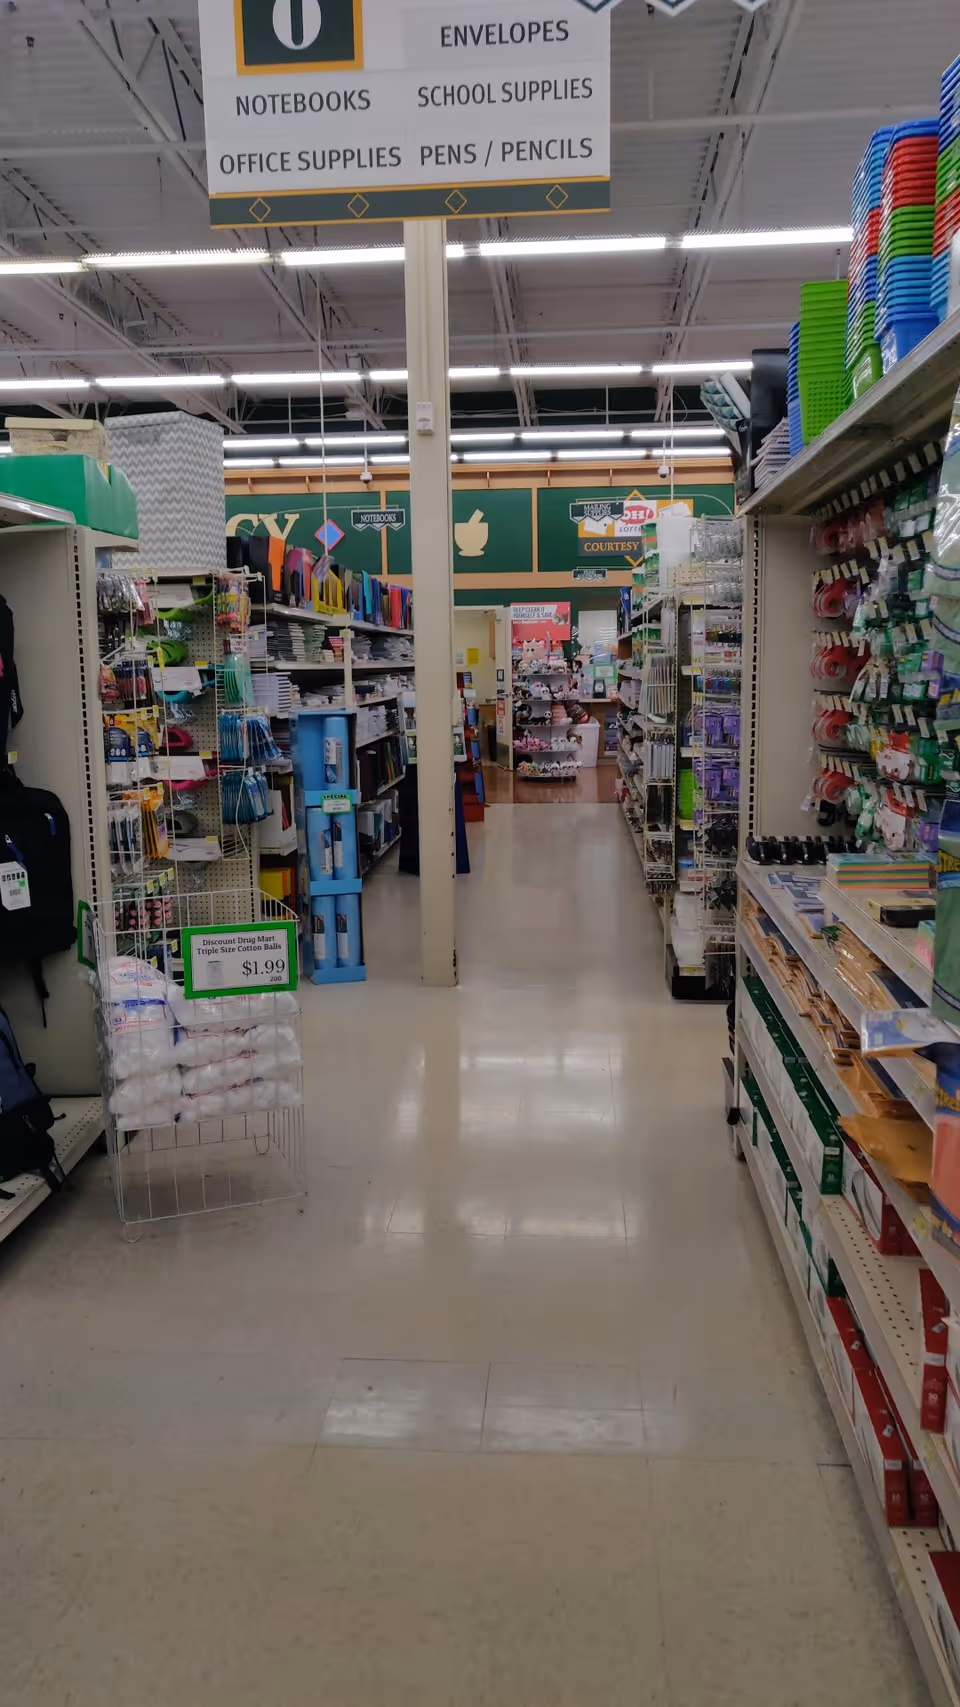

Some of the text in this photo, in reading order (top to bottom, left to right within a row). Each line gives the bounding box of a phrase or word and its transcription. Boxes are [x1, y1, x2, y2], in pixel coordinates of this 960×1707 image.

[440, 20, 569, 48] ENVELOPES
[235, 89, 371, 117] NOTEBOOKS
[417, 77, 593, 108] SCHOOL SUPPLIES
[219, 145, 402, 175] OFFICE SUPPLIES
[419, 137, 593, 168] PENS / PENCILS
[360, 512, 397, 523] NOTEBOOKS
[584, 541, 640, 552] COURTESY
[197, 942, 282, 956] Triple Size Cotton Balls
[202, 935, 275, 947] Discount Drug Mart
[242, 958, 286, 980] $1.99
